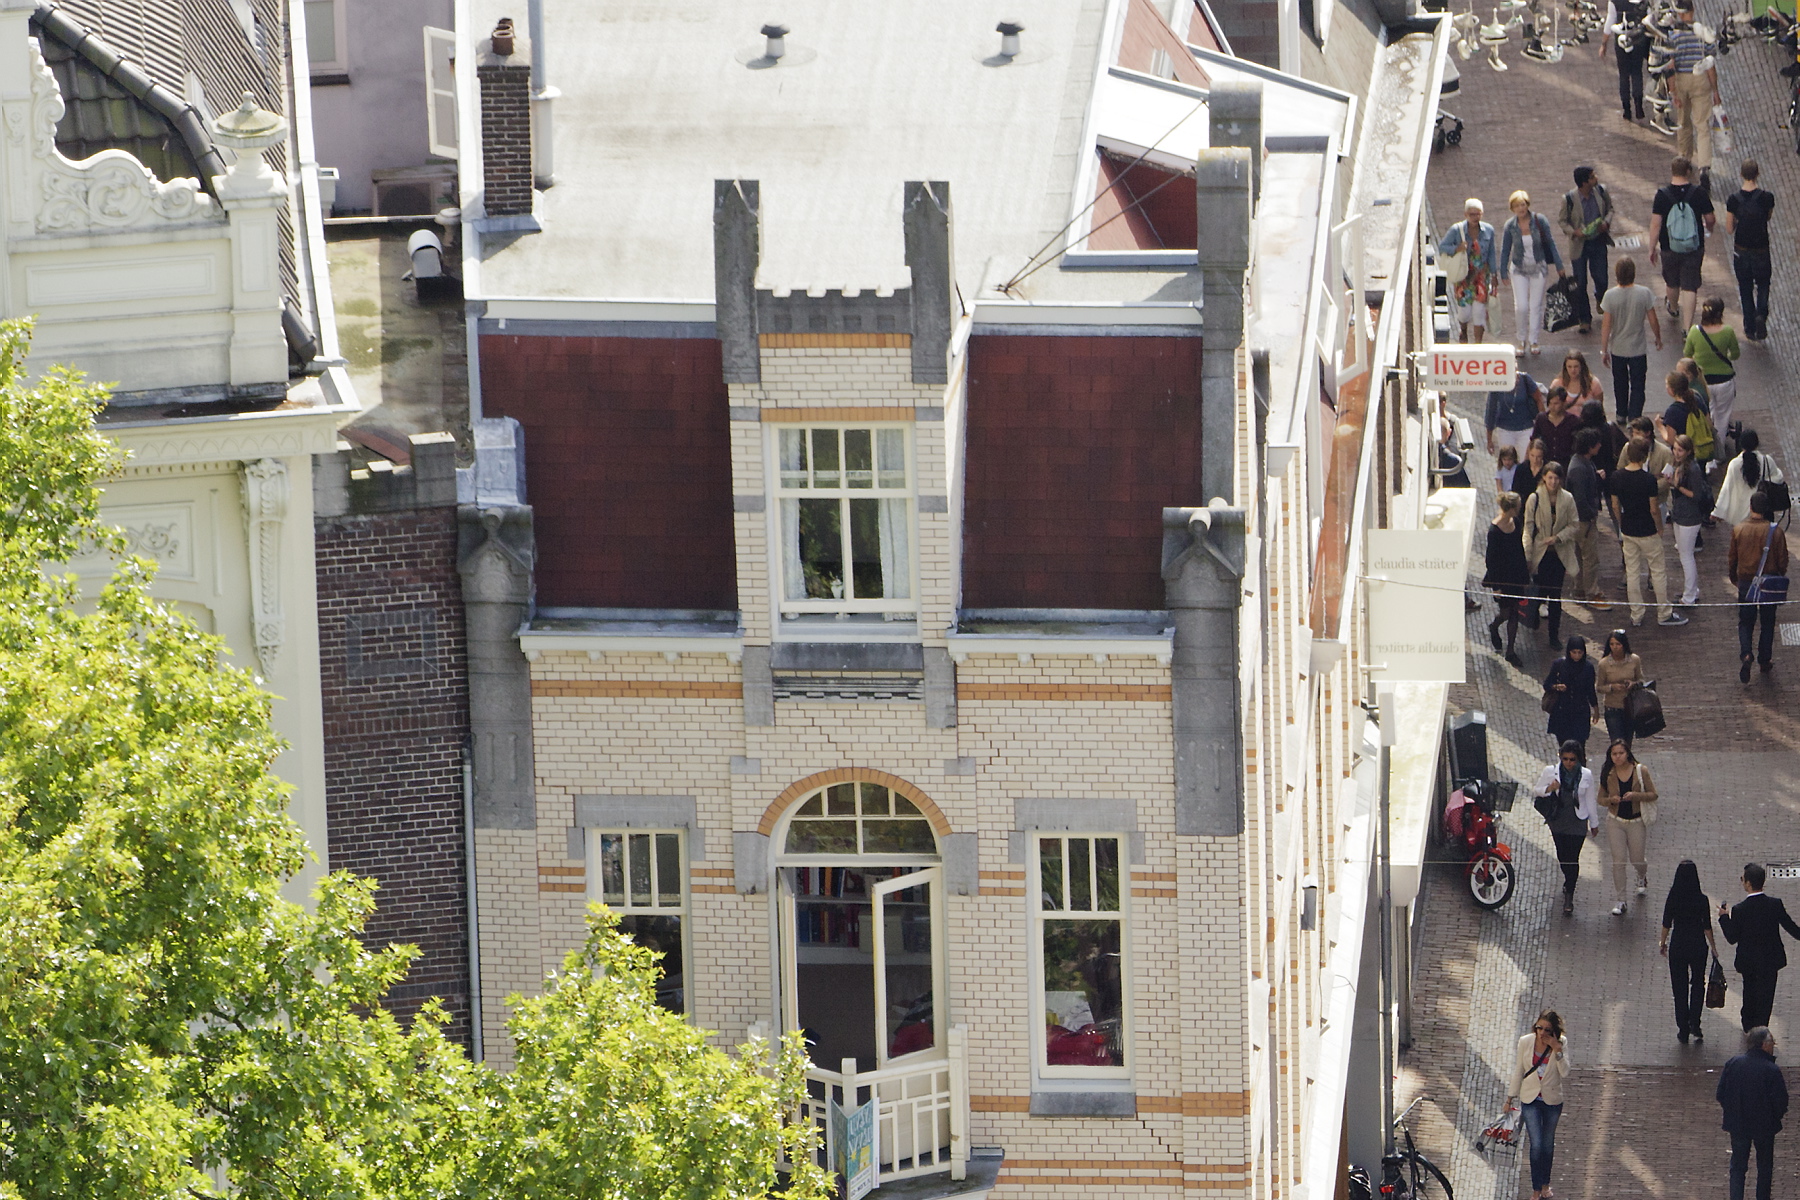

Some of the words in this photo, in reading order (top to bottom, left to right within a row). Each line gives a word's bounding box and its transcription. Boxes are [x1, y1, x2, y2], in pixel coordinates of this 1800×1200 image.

[1434, 353, 1507, 375] livera
[1374, 557, 1415, 570] claudia
[1418, 557, 1459, 570] sträter
